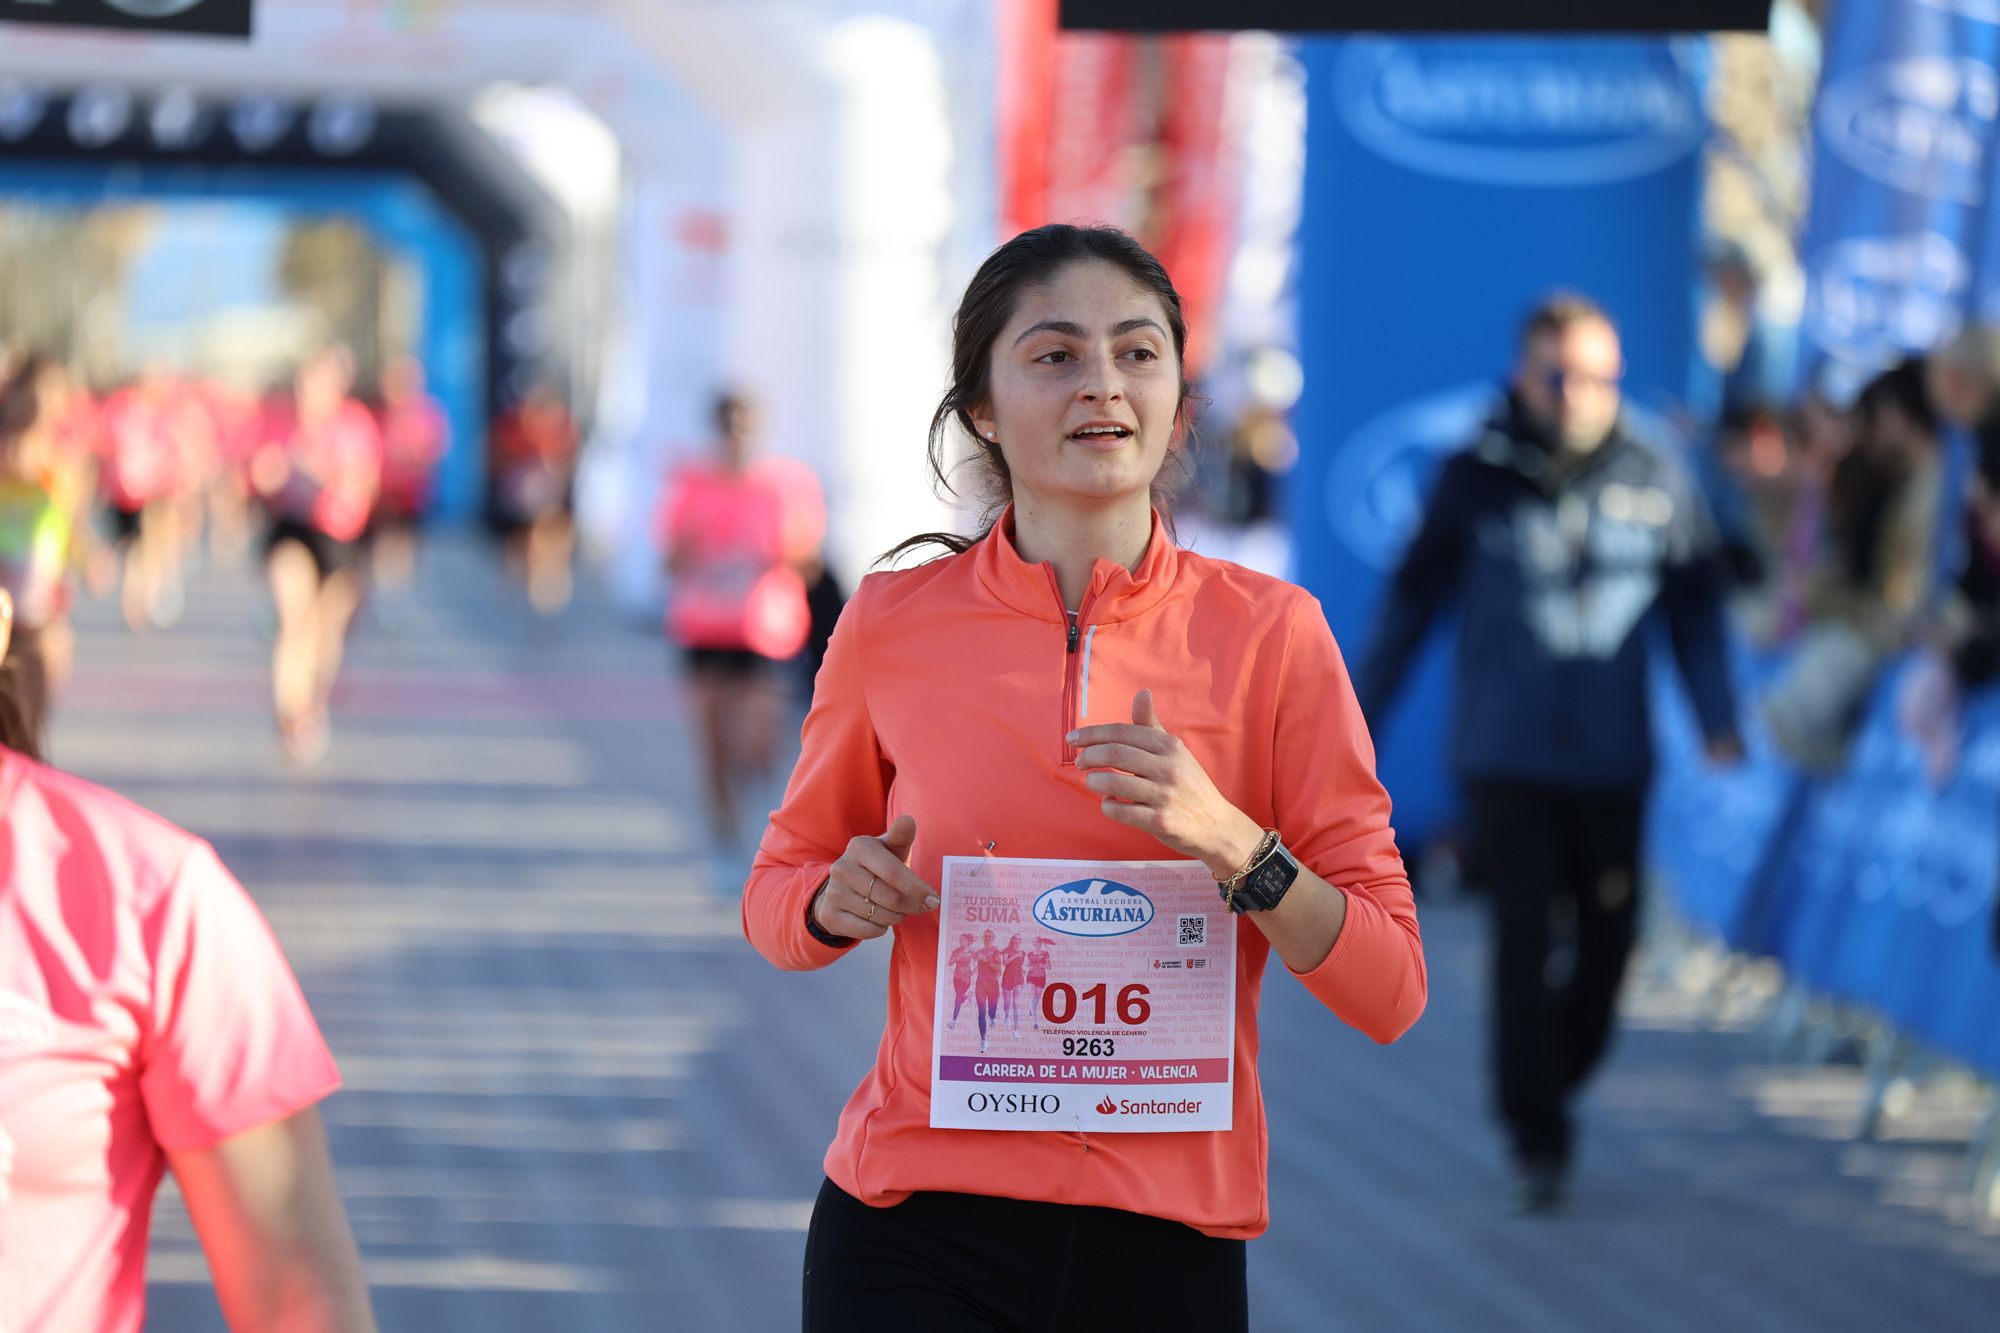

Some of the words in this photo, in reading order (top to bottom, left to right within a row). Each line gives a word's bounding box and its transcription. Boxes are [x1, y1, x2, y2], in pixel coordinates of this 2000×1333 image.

[964, 896, 978, 906] TU
[980, 896, 1021, 907] DORSAL
[1041, 898, 1146, 922] ASTURIANA
[966, 907, 1021, 924] SUMA
[1042, 982, 1151, 1025] 016
[1062, 1037, 1115, 1057] 9263
[974, 1062, 1035, 1078] CARRERA
[1039, 1064, 1057, 1078] DE
[1061, 1065, 1078, 1078] LA
[1082, 1065, 1127, 1079] MUJER
[1140, 1064, 1198, 1079] VALENCIA
[968, 1092, 1061, 1114] OYSHO
[1120, 1098, 1202, 1115] Santander
